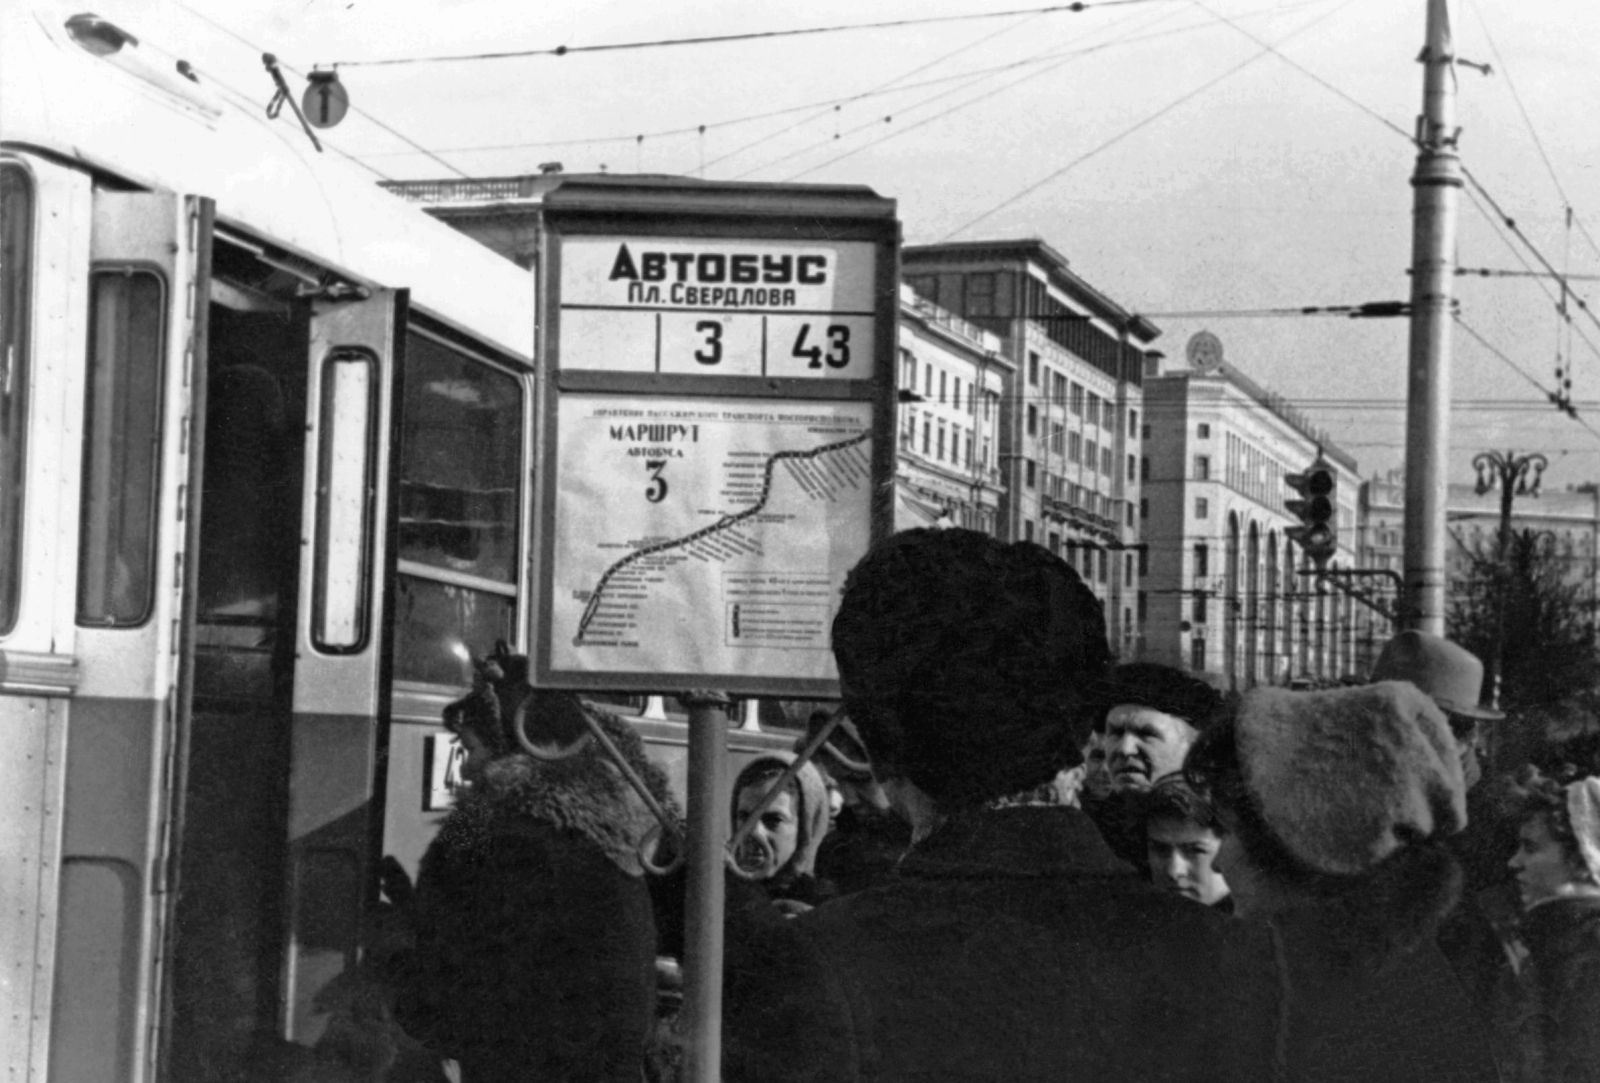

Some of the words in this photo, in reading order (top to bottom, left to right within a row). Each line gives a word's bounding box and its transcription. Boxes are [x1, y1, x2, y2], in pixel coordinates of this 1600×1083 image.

[608, 242, 828, 285] АВТОБУС
[670, 282, 796, 307] СВЕРДЛОВА
[694, 320, 724, 366] 3
[791, 323, 851, 369] 43
[609, 424, 699, 443] МАРШРУТ
[627, 447, 684, 458] АВТОБУСА
[645, 460, 669, 503] 3
